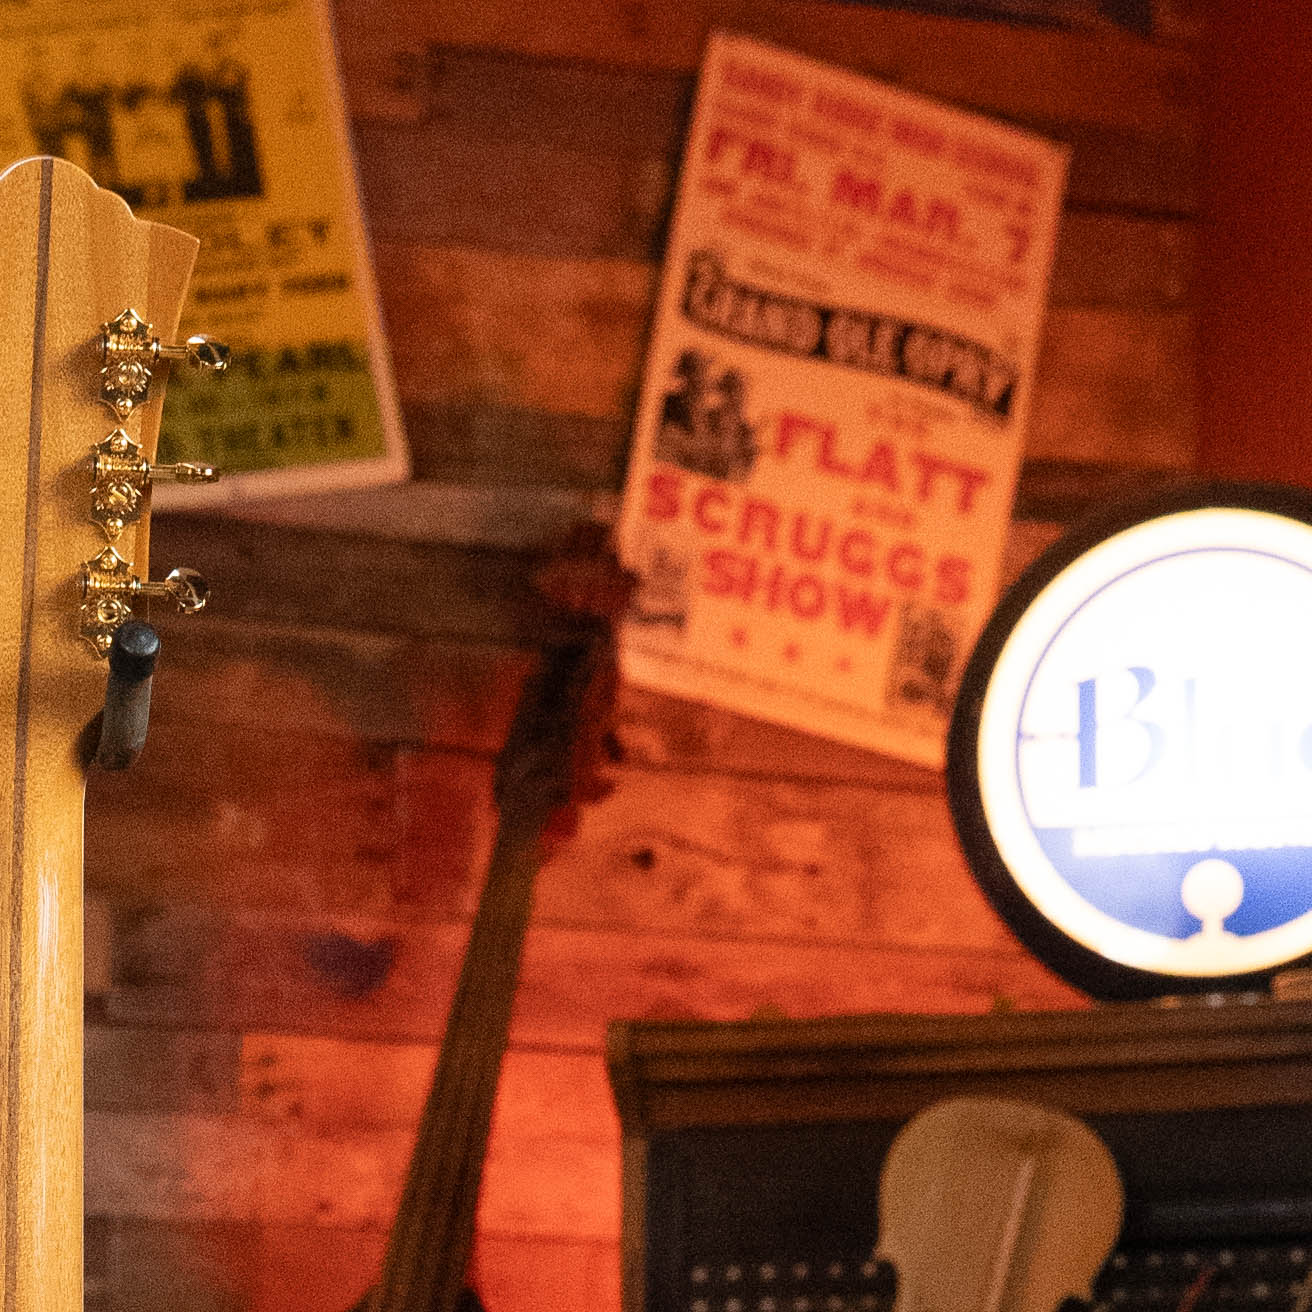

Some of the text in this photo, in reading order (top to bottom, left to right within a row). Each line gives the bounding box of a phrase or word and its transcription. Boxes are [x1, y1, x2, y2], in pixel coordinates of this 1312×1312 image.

[774, 412, 990, 515] FLATT
[645, 470, 971, 606] SCRUGGS
[702, 547, 890, 640] SHOW
